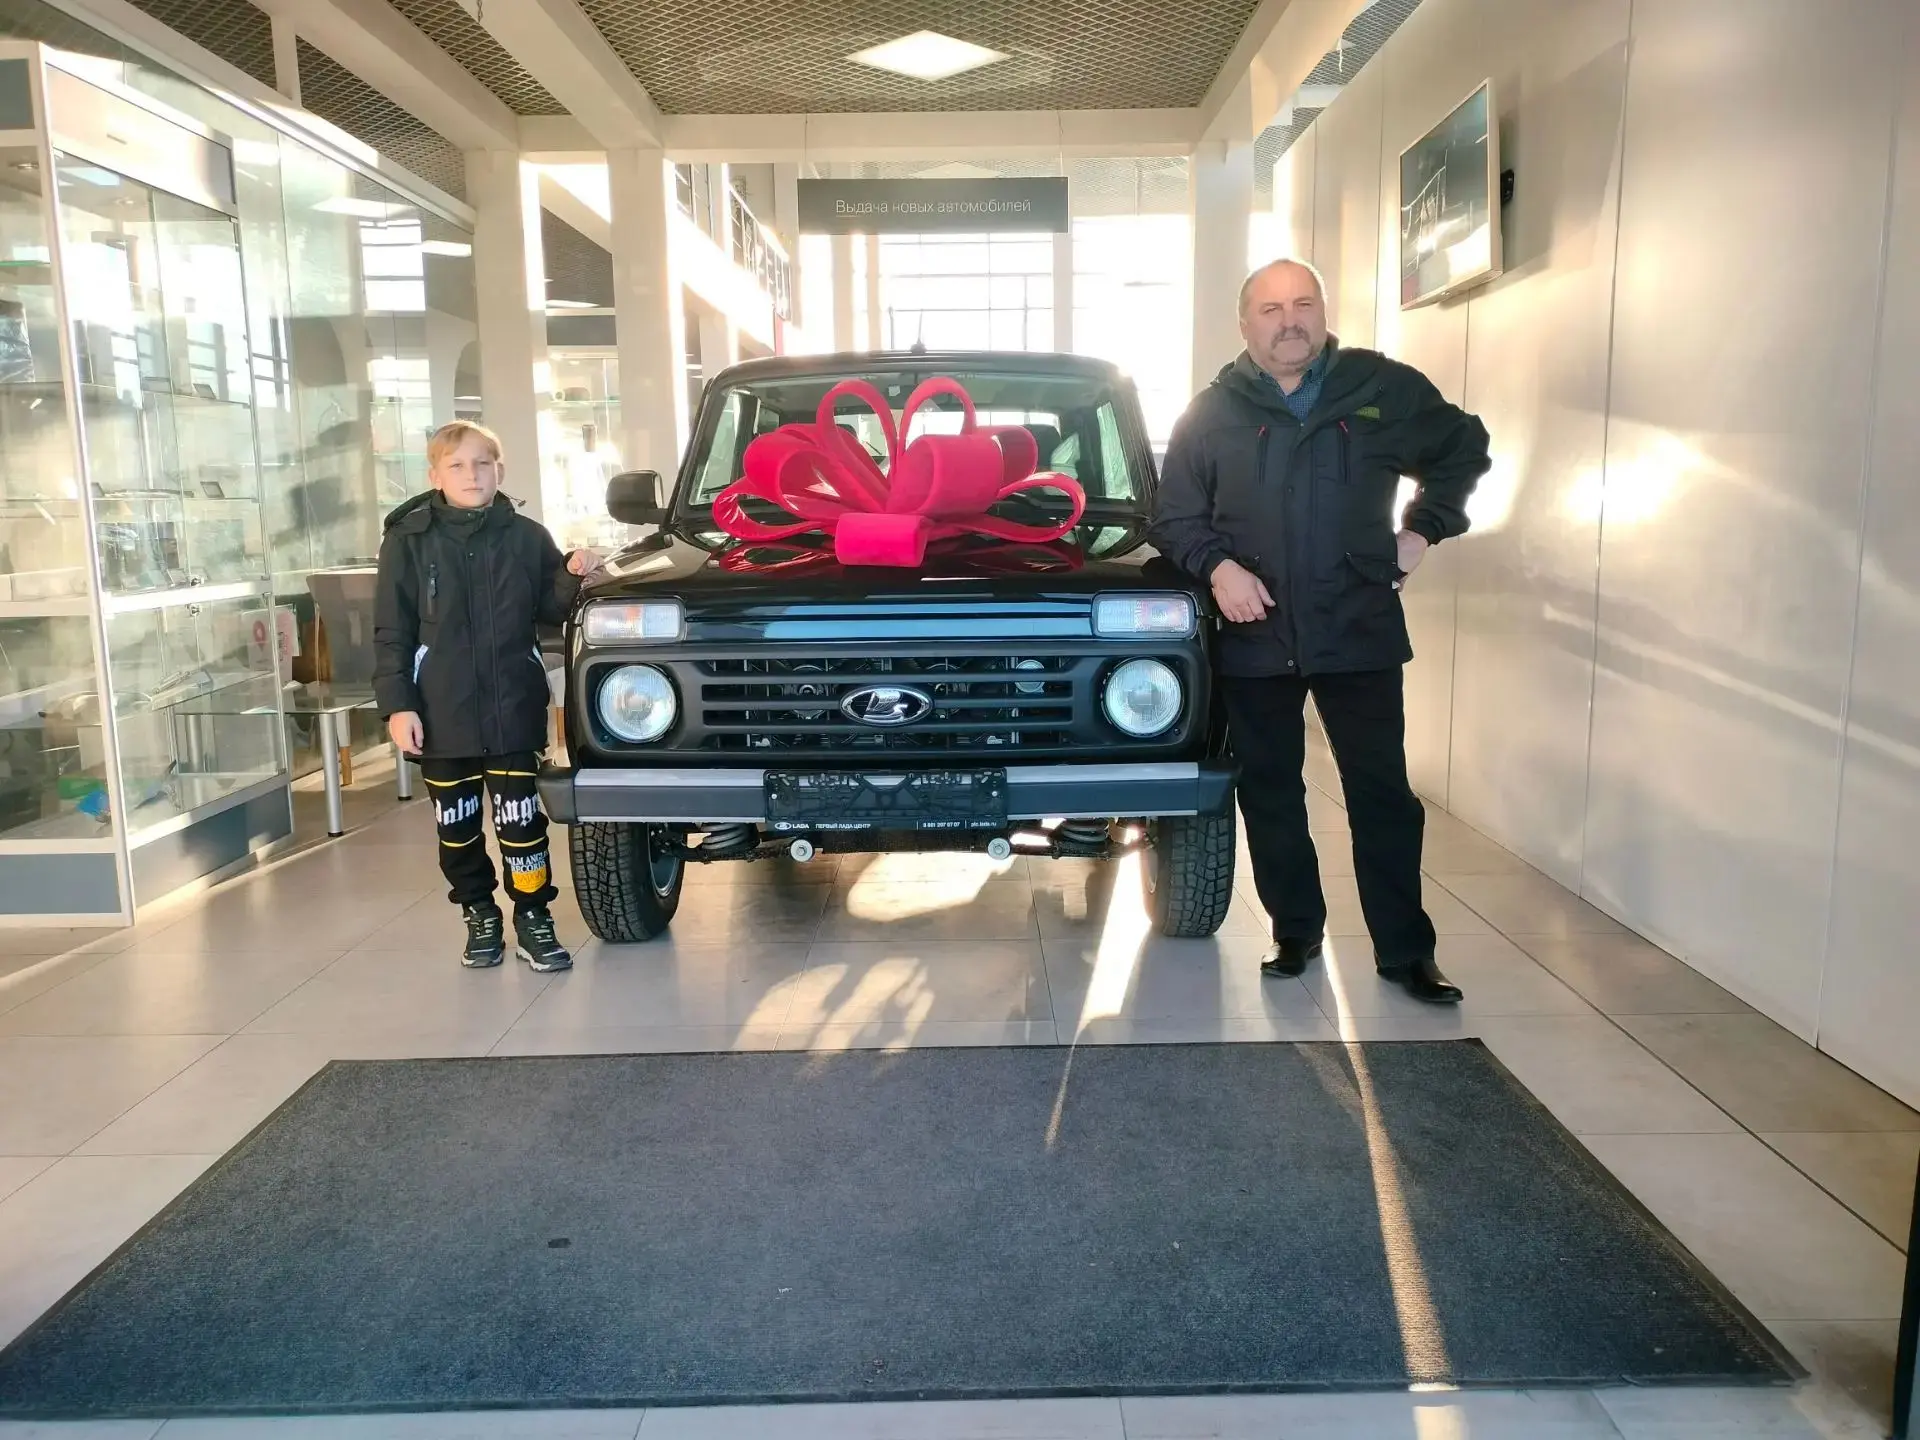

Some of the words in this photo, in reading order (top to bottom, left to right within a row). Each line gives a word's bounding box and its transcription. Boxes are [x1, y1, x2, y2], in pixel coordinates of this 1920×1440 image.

[836, 199, 888, 214] Выдача
[892, 202, 934, 213] новых
[937, 199, 1031, 213] автомобилей
